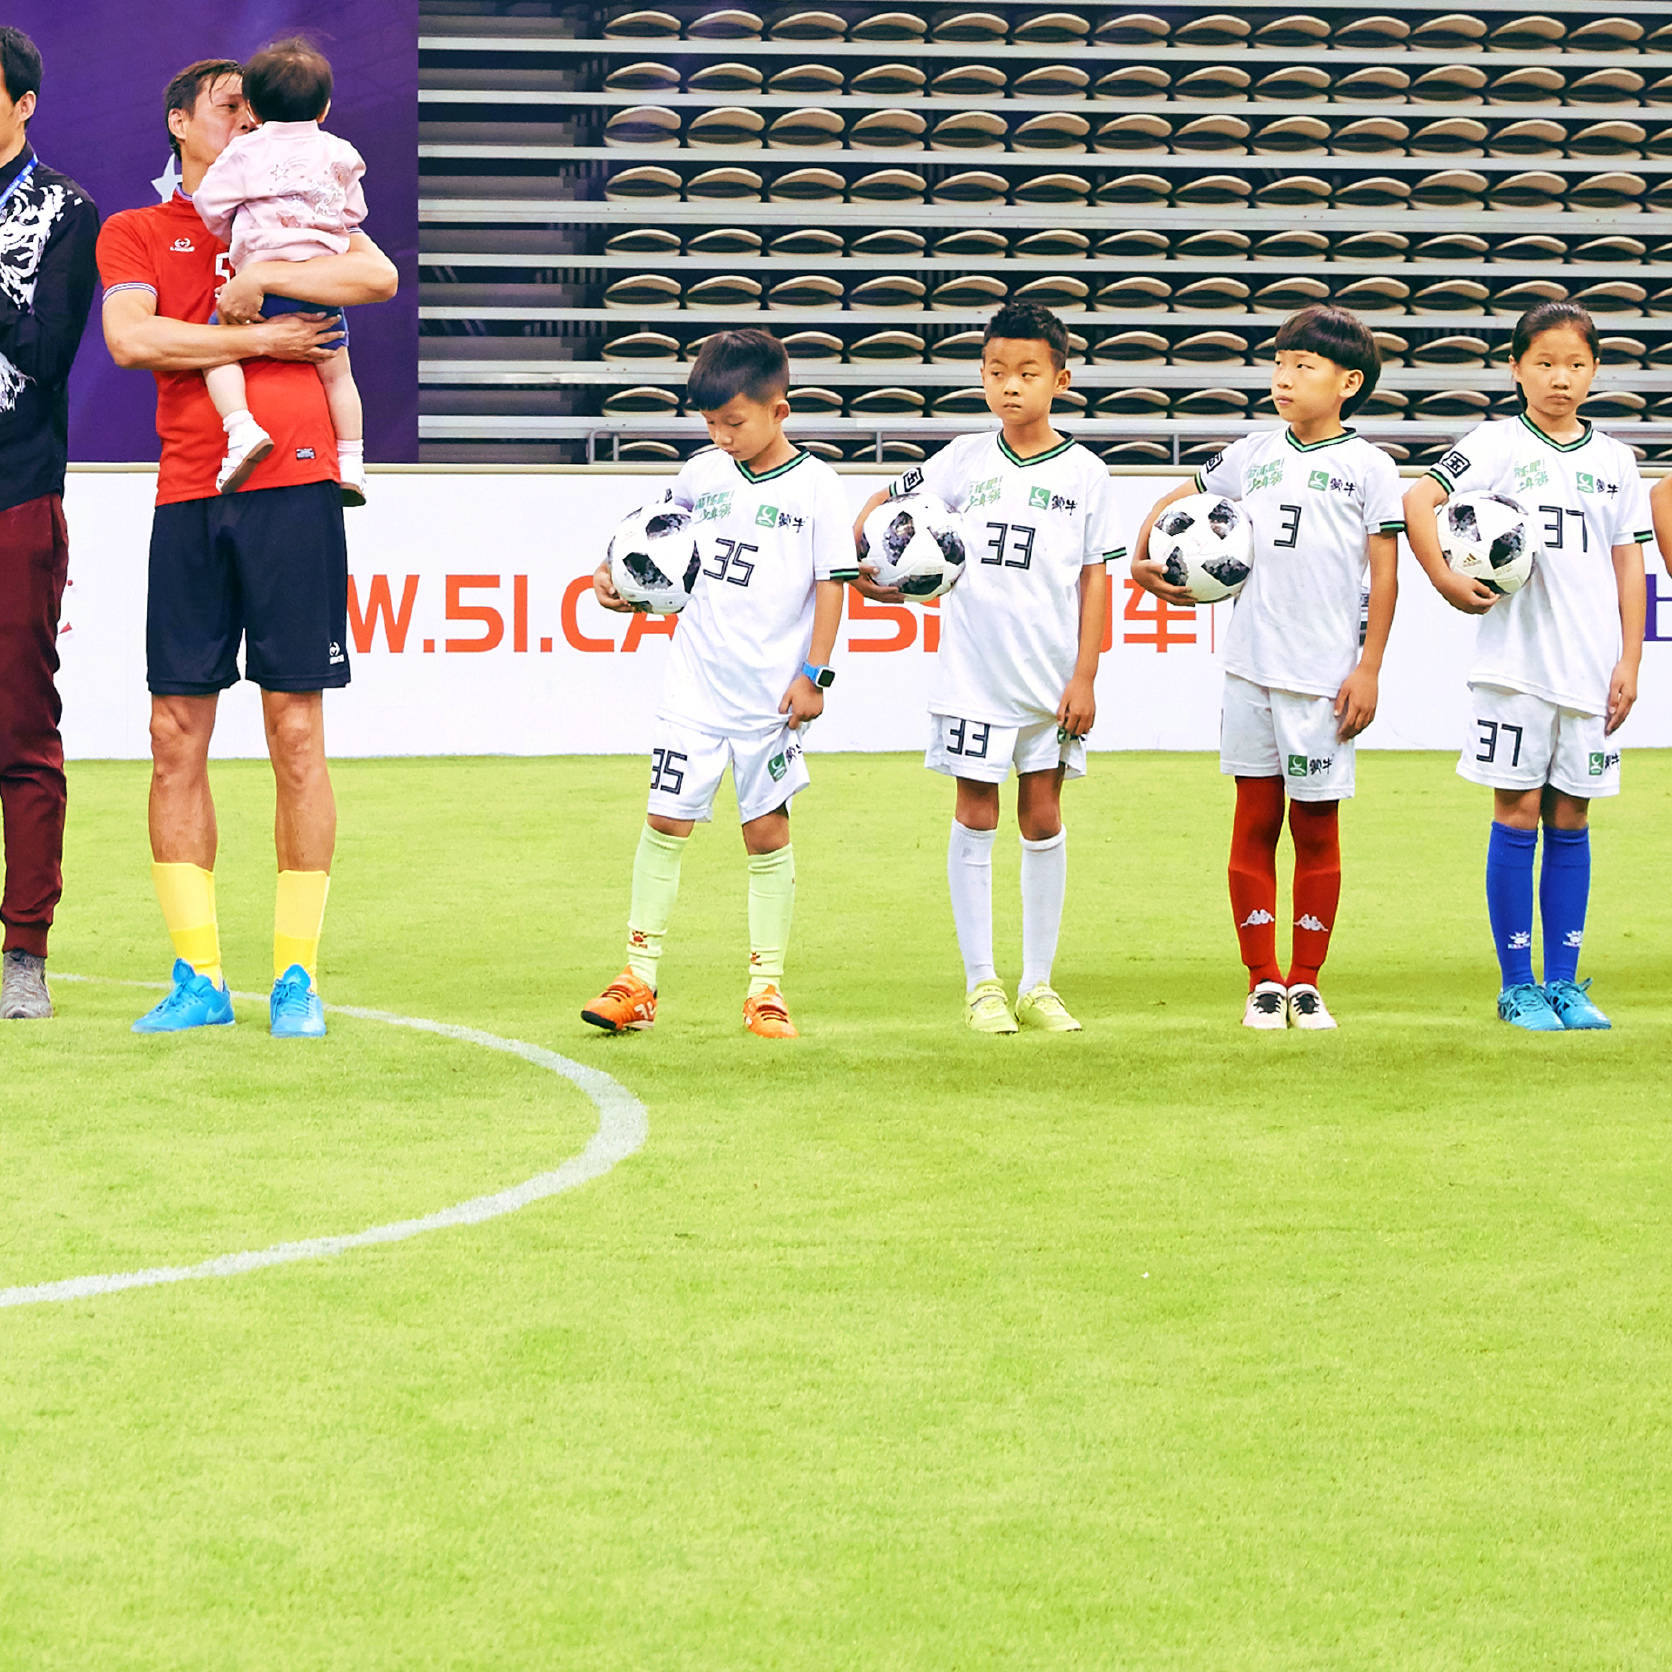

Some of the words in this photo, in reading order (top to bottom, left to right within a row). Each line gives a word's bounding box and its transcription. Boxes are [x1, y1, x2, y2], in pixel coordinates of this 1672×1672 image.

[981, 521, 1036, 570] 33
[1274, 504, 1302, 548] 3
[1539, 504, 1589, 553] 37
[702, 537, 759, 588] 35
[947, 718, 992, 759] 33
[1475, 720, 1524, 768] 37
[650, 748, 689, 795] 35
